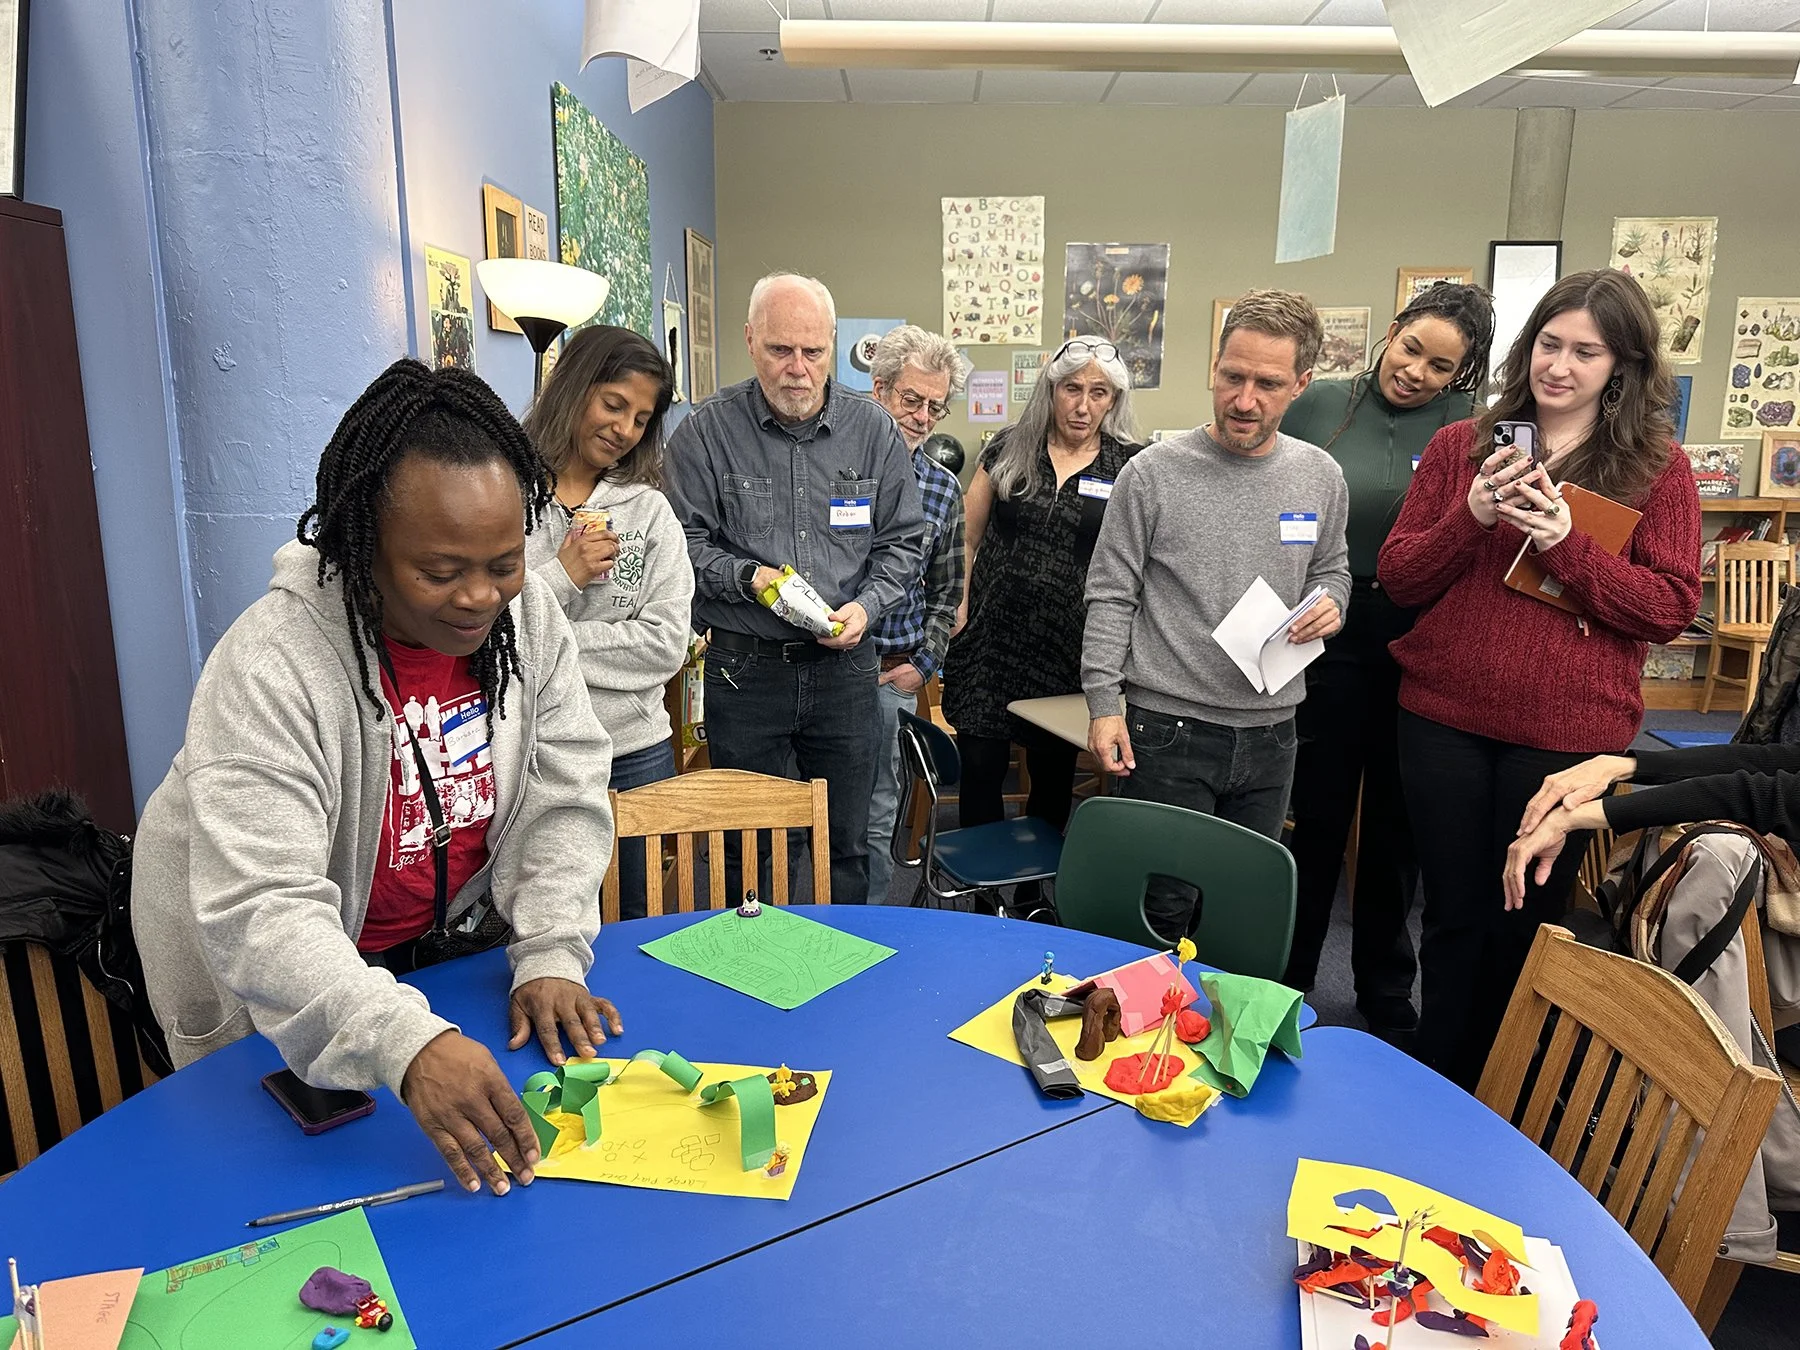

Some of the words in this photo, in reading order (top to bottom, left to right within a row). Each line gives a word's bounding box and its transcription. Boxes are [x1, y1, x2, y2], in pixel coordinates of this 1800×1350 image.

[948, 202, 959, 215] A
[979, 199, 988, 210] B
[1009, 200, 1020, 212] C
[529, 212, 545, 235] READ
[970, 217, 981, 228] D
[988, 213, 997, 224] E
[1017, 215, 1026, 228] F
[948, 232, 959, 244] G
[1005, 229, 1015, 241] H
[1034, 233, 1039, 245] I
[530, 244, 546, 261] BOOKS
[948, 249, 956, 262] J
[980, 246, 990, 257] K
[1029, 250, 1038, 261] L
[958, 264, 970, 276] M
[989, 262, 1000, 273] N
[1016, 269, 1029, 282] O
[965, 281, 974, 293] P
[999, 280, 1011, 293] Q
[1028, 289, 1038, 301] R
[954, 295, 961, 307] S
[987, 297, 997, 310] T
[1015, 305, 1025, 317] U
[949, 312, 960, 323] V
[998, 314, 1010, 325] W
[1025, 324, 1035, 335] X
[967, 327, 977, 339] Y
[998, 332, 1008, 343] Z
[1699, 485, 1732, 494] MARKET
[612, 567, 638, 592] ERNHILL
[611, 595, 637, 609] TEA
[460, 706, 480, 720] Hello
